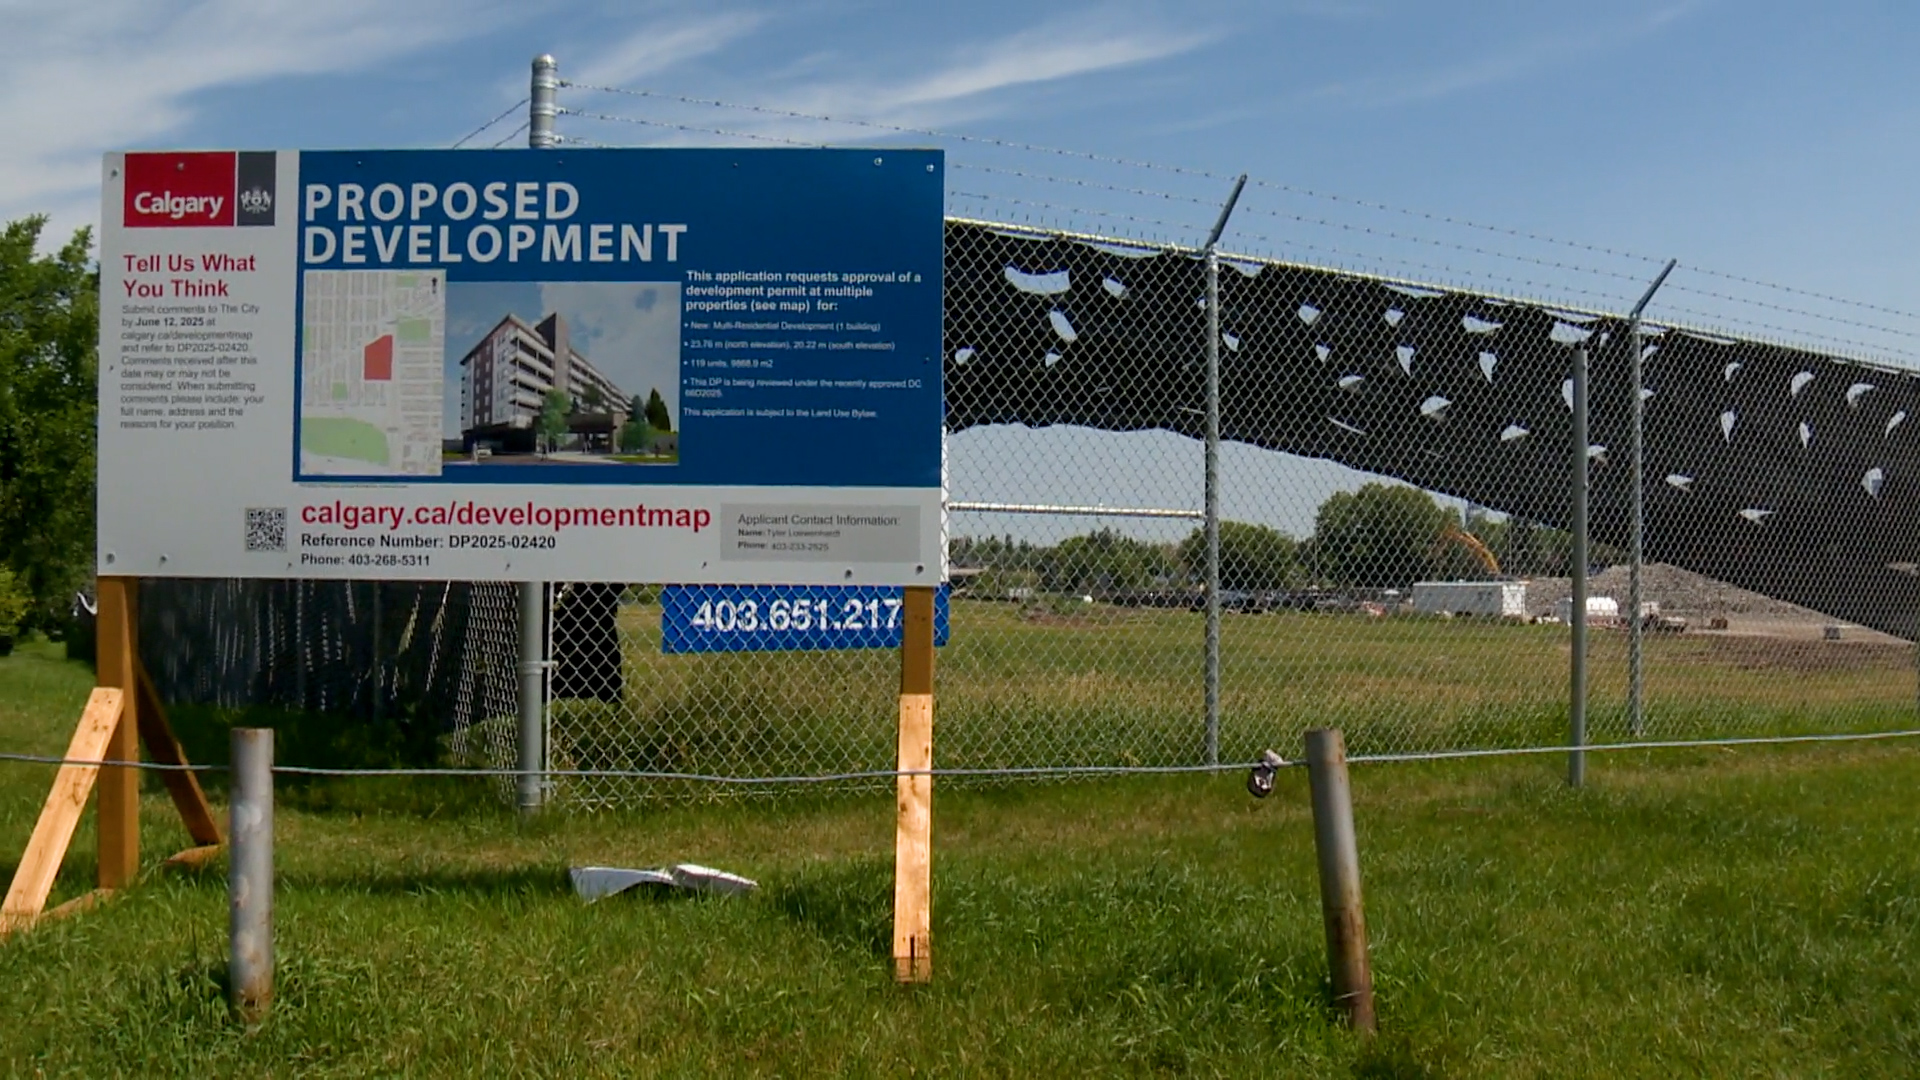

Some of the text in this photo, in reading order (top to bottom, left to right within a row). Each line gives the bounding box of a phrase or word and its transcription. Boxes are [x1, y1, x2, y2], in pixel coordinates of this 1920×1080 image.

[134, 190, 224, 220] Calgary
[305, 182, 580, 222] PROPOSED
[304, 223, 688, 264] DEVELOPMENT
[124, 253, 256, 272] Tell Us What
[687, 270, 922, 285] This application requests approval of a
[123, 279, 229, 298] You Think
[686, 285, 873, 299] development permit at multiple
[122, 303, 260, 315] Submit comments to The City
[685, 299, 838, 313] properties (see map) for:
[121, 317, 216, 328] by June 12, 2025 at
[781, 322, 834, 332] Development
[846, 322, 881, 333] building)
[121, 344, 139, 353] and
[141, 344, 163, 352] refer
[165, 344, 175, 352] to
[714, 341, 723, 349] m
[724, 340, 749, 350] (north
[121, 356, 257, 365] Comments received after this
[121, 369, 142, 378] date
[144, 370, 164, 379] may
[178, 370, 199, 379] may
[201, 369, 216, 378] not
[219, 369, 231, 378] be
[177, 381, 205, 390] When
[207, 381, 256, 391] submitting
[690, 377, 707, 386] This
[708, 377, 722, 386] DP
[732, 378, 755, 388] being
[795, 379, 818, 387] under
[819, 379, 833, 387] the
[868, 379, 906, 389] approved
[121, 394, 169, 403] comments
[171, 395, 203, 404] please
[243, 396, 265, 405] your
[121, 407, 134, 416] full
[168, 407, 205, 416] address
[208, 407, 227, 416] and
[228, 407, 244, 416] the
[683, 407, 701, 417] This
[702, 408, 745, 418] application
[755, 409, 785, 418] subject
[786, 409, 795, 417] to
[796, 409, 809, 417] the
[811, 409, 832, 418] Land
[833, 409, 850, 418] Use
[159, 420, 172, 428] for
[174, 421, 196, 430] your
[302, 501, 711, 532] calgary.ca/developmentmap
[738, 514, 900, 527] Applicant Contact Information:
[301, 535, 556, 549] Reference Number: DP2025-02420
[301, 554, 430, 566] Phone: 403-268-5311
[692, 598, 904, 632] 403.651.217
